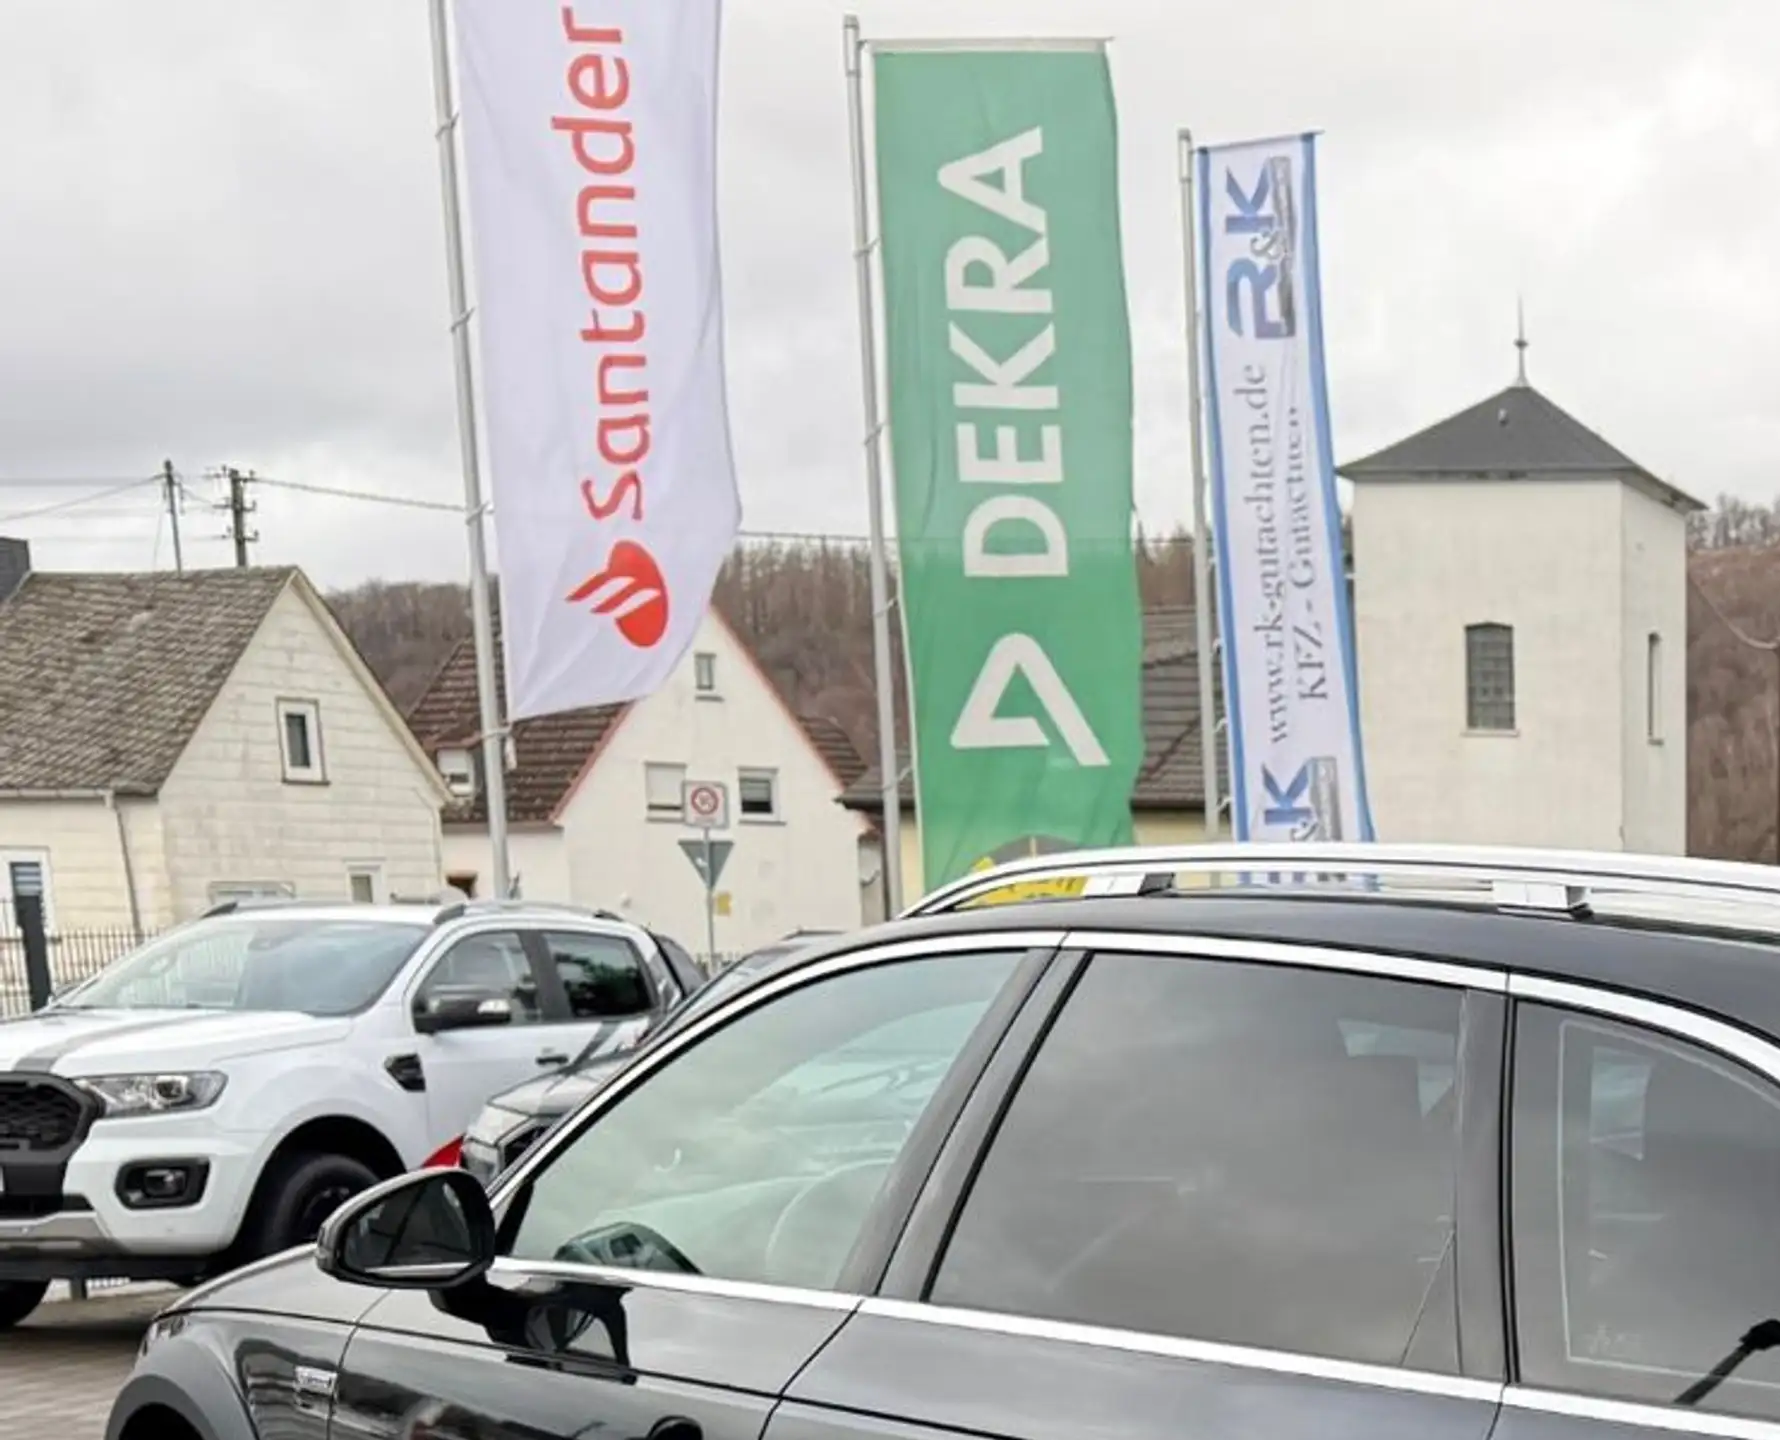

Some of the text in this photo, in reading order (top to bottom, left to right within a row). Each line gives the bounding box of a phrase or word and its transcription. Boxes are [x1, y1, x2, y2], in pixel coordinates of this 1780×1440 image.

[552, 6, 651, 521] Santander
[937, 125, 1069, 578] DEKRA
[1233, 363, 1287, 743] www.rk-gutachten.de
[1292, 620, 1328, 700] KFZ
